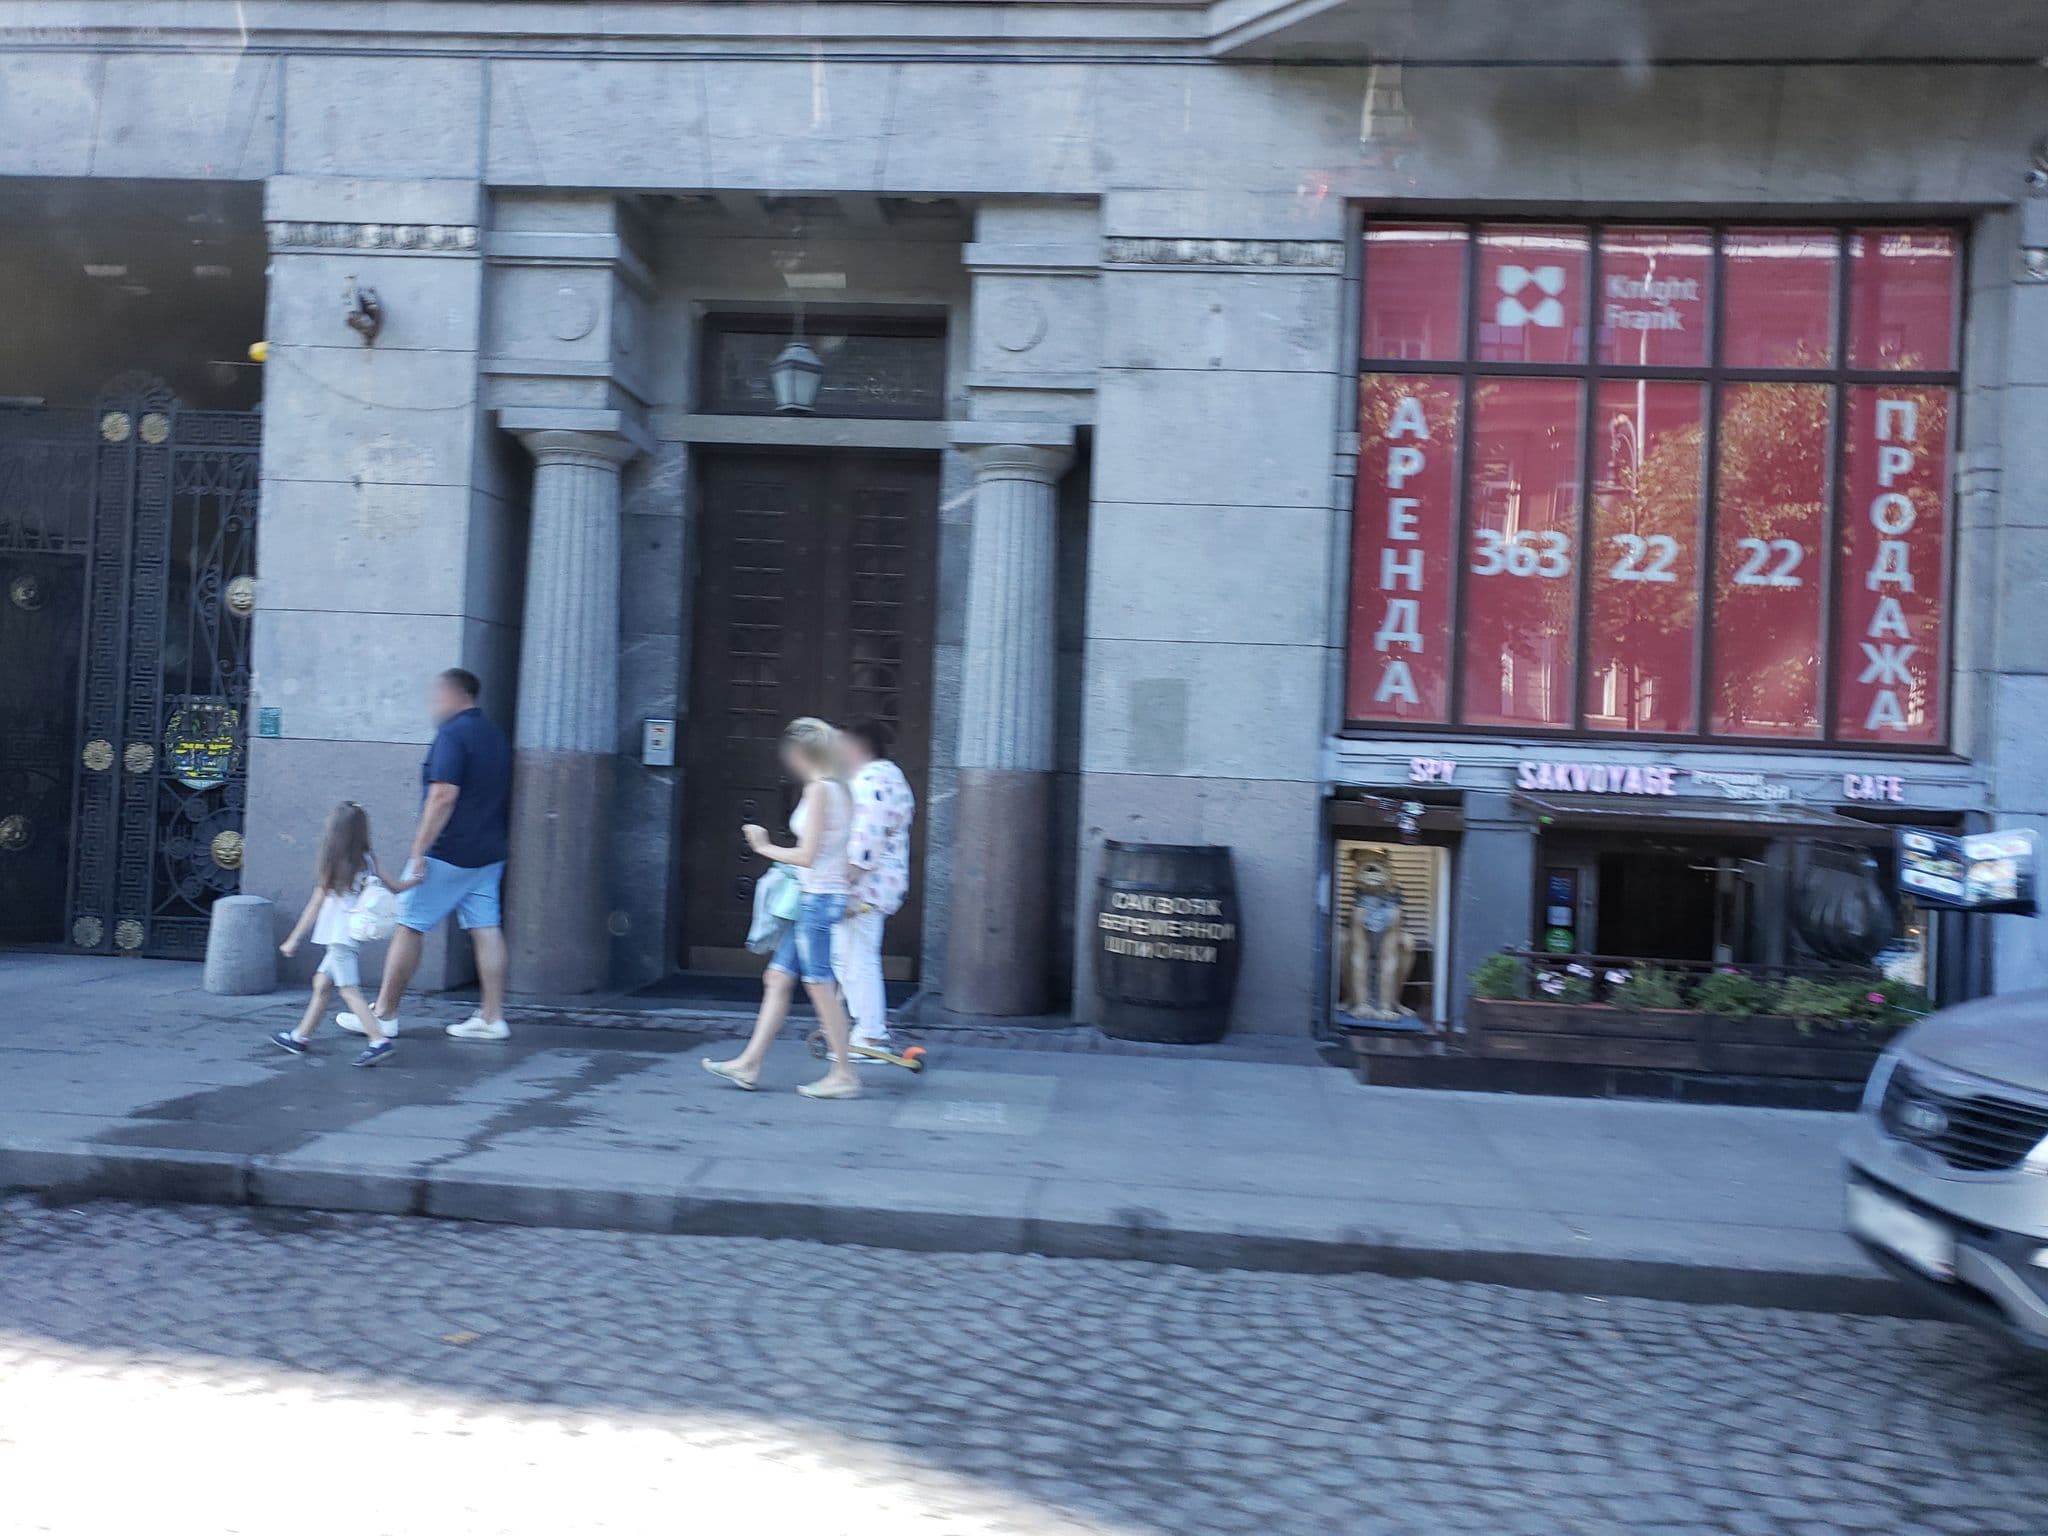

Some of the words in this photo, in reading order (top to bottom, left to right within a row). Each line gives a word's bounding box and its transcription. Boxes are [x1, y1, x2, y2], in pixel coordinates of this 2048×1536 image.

[1606, 274, 1699, 307] Knight
[1606, 304, 1686, 332] Frank
[1375, 396, 1430, 703] АРЕНДА
[1471, 528, 1571, 577] 363
[1610, 533, 1679, 582] 22
[1733, 538, 1804, 587] 22
[1857, 399, 1917, 731] ПРОДАЖА
[1408, 757, 1456, 784] SPY
[1516, 761, 1677, 795] SAKVOYAGE
[1843, 773, 1904, 801] CAFE
